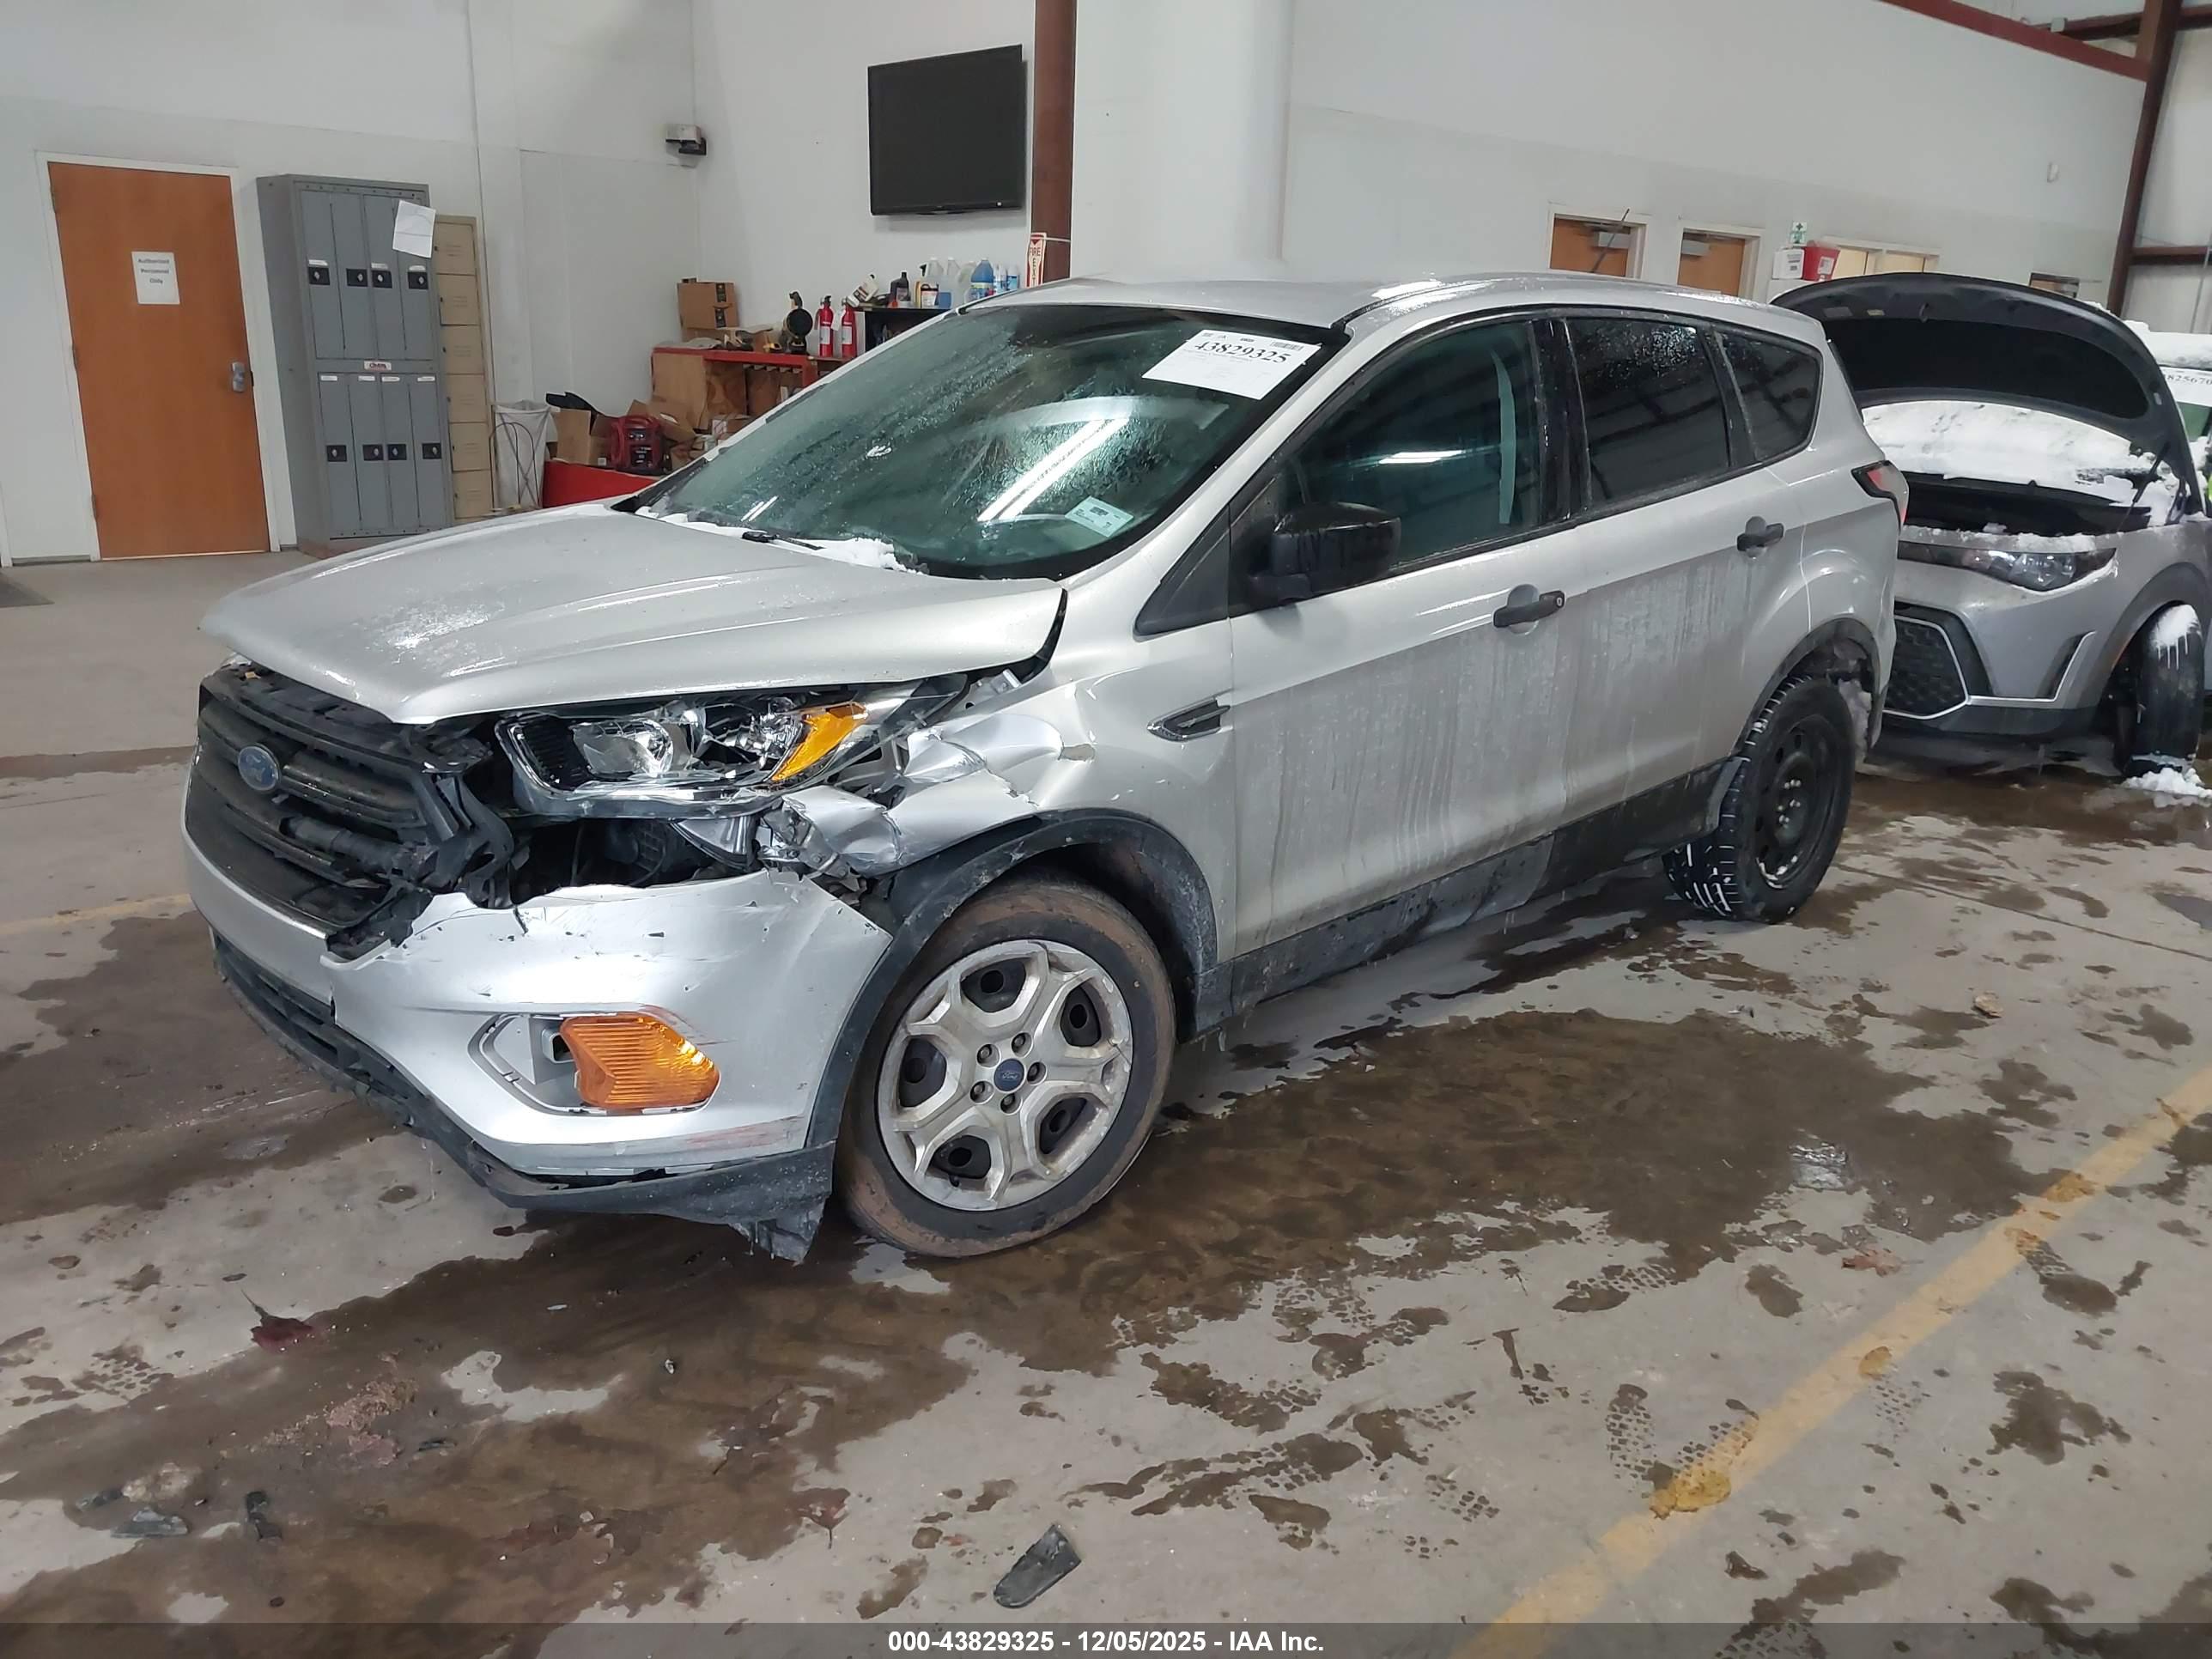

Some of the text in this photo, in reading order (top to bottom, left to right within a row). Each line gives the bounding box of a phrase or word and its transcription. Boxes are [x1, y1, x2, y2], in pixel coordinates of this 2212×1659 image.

[1030, 246, 1042, 257] FIRE
[1194, 341, 1291, 364] 43829325
[2165, 374, 2212, 386] 825670
